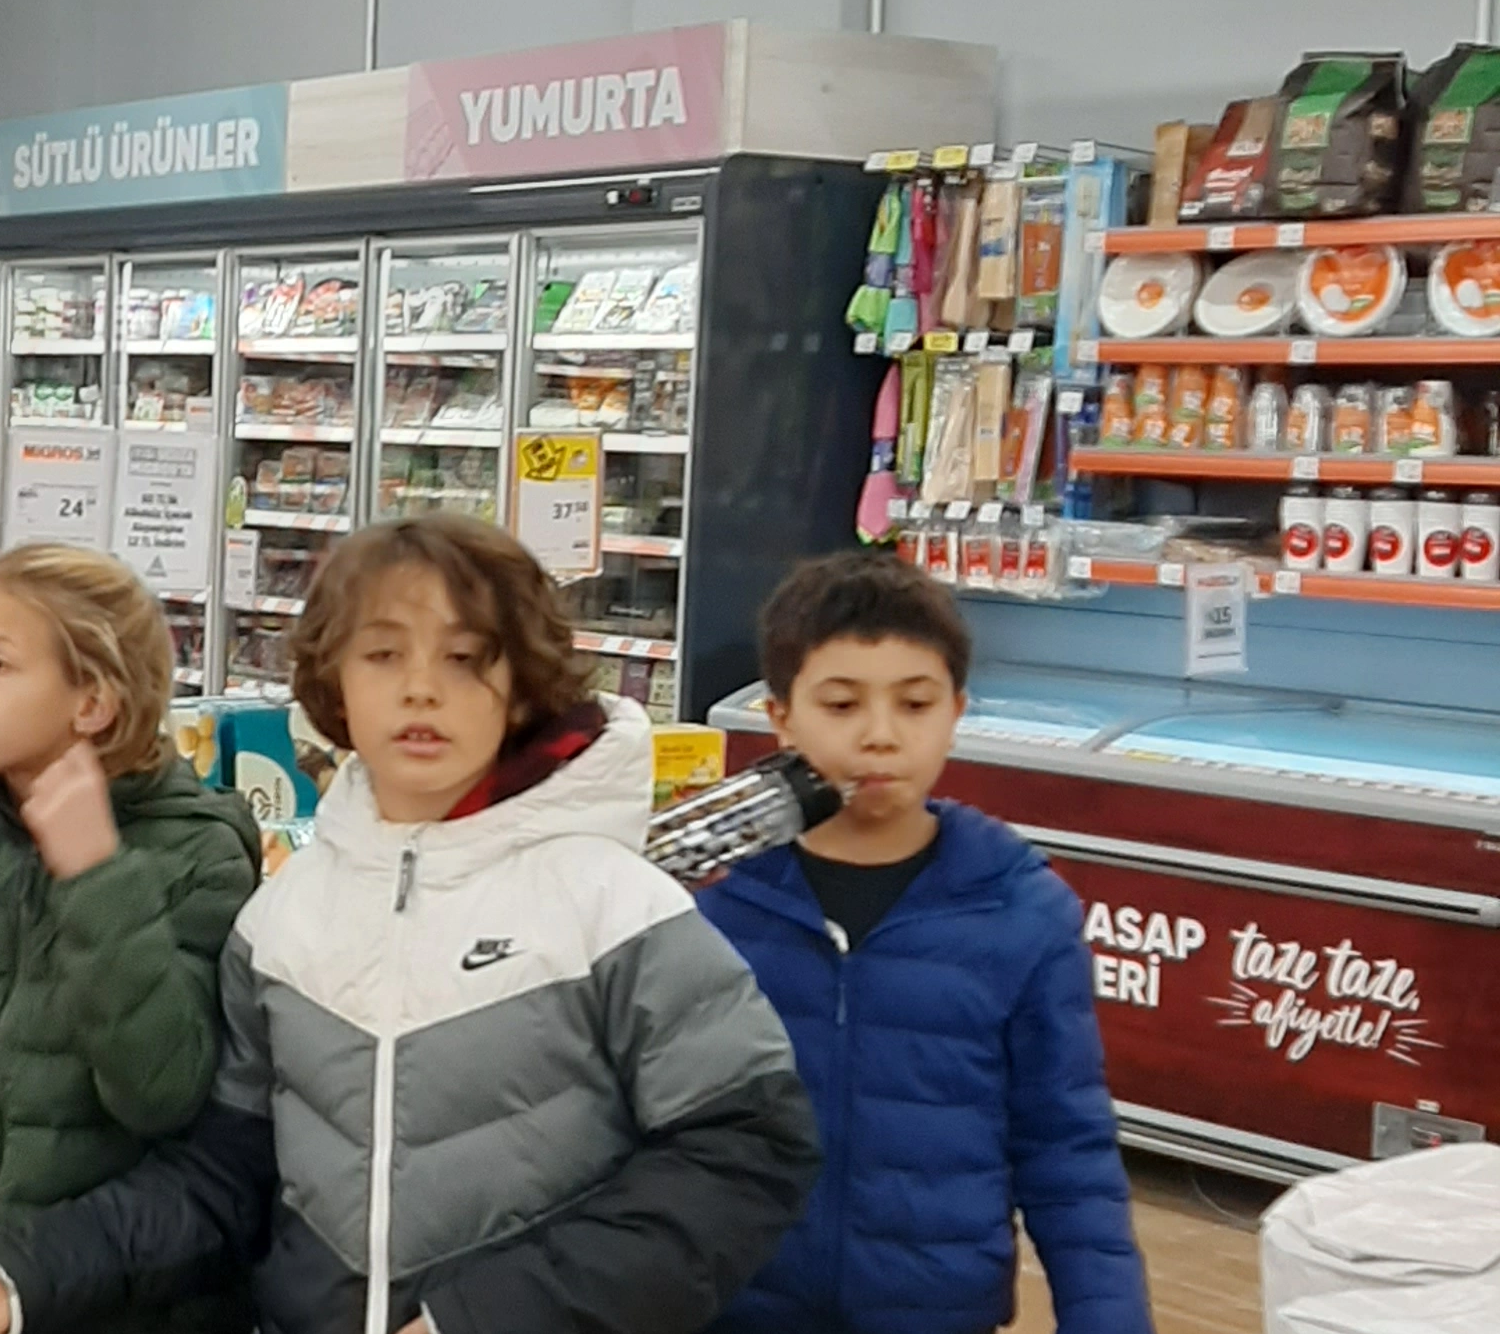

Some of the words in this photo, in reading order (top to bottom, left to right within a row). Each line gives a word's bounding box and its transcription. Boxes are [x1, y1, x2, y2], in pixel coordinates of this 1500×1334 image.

[460, 68, 687, 145] YUMURTA
[11, 125, 102, 189] SÜTLÜ
[110, 116, 260, 178] ÜRÜNLER
[1083, 900, 1206, 960] ASAP
[1230, 922, 1320, 989] taze
[1092, 953, 1160, 1007] ERİ
[1252, 989, 1391, 1061] afiyetle!
